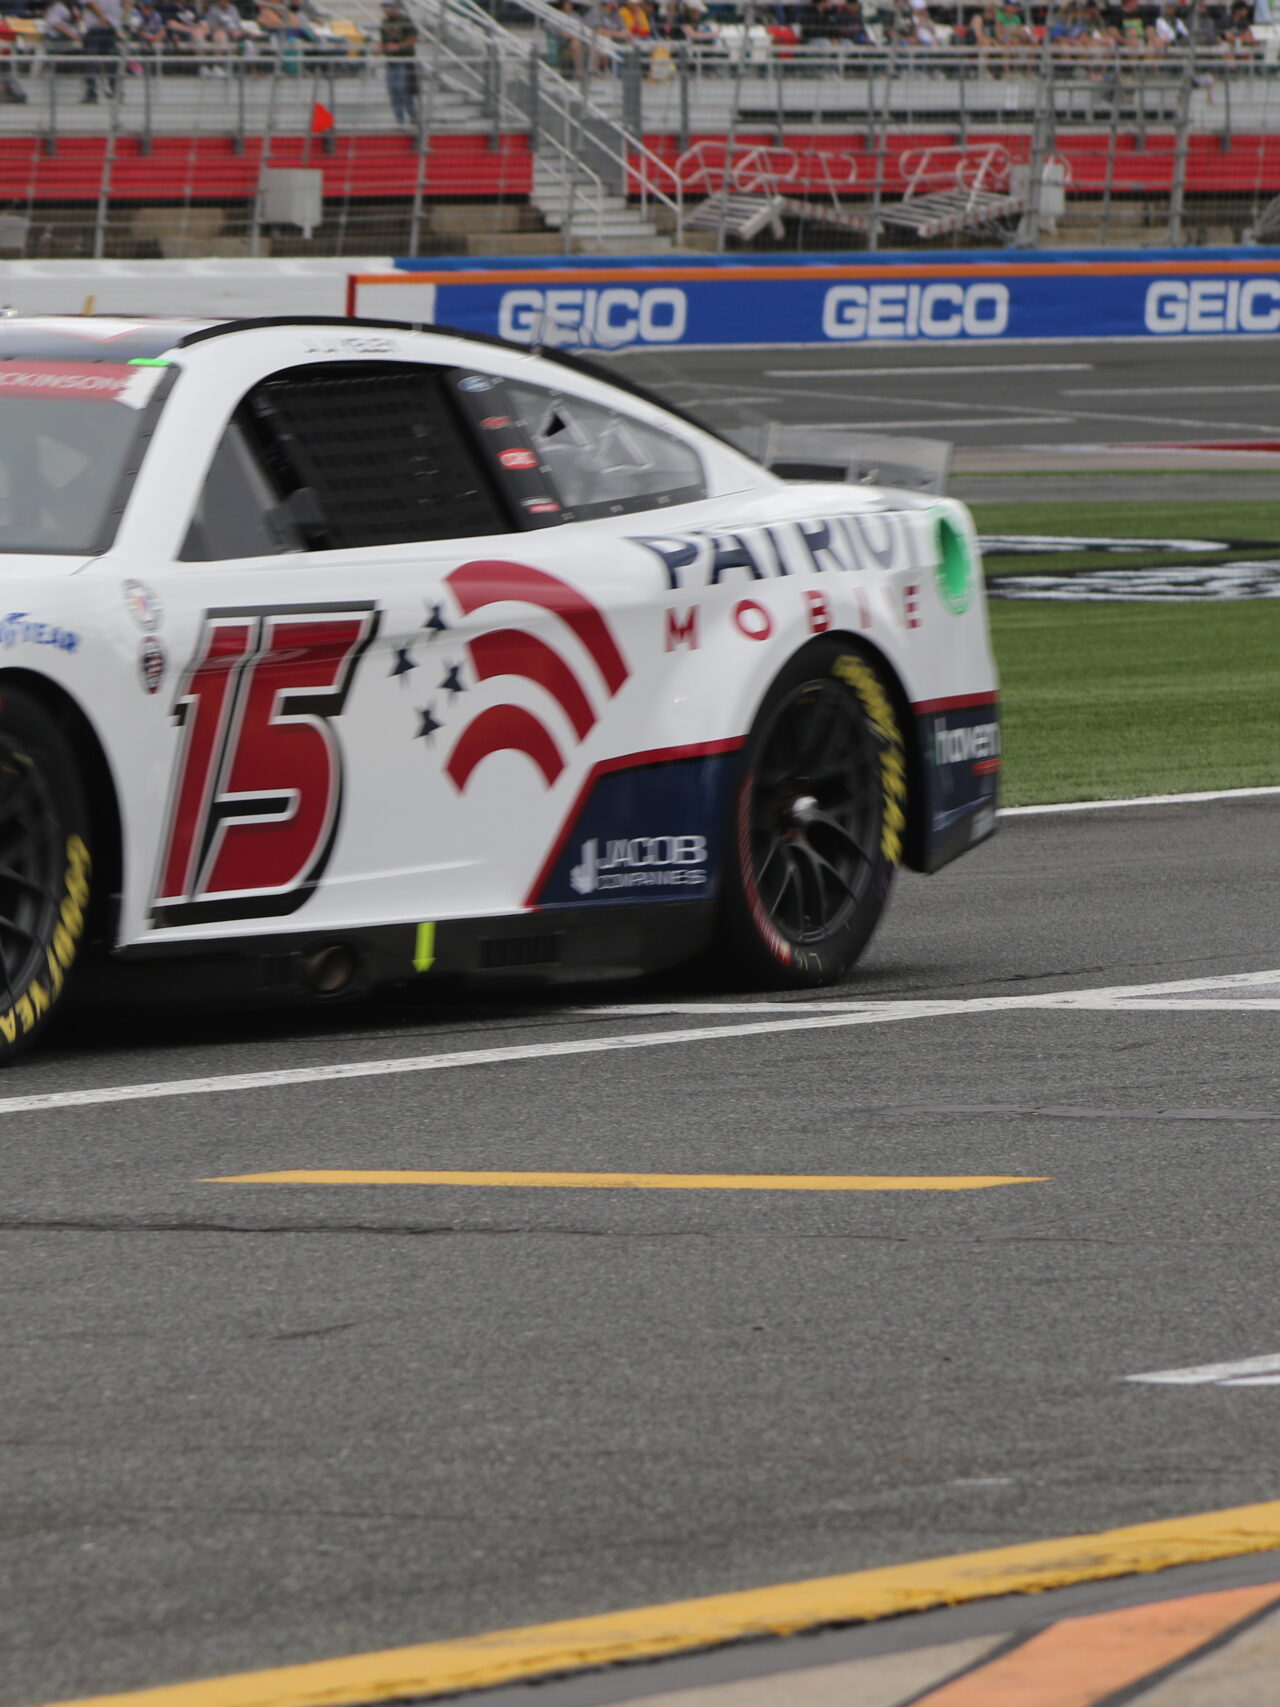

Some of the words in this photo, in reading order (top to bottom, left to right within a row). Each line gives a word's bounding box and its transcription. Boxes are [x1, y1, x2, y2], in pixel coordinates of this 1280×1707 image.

[498, 288, 687, 346] GEICO
[822, 283, 1010, 339] GEICO
[1144, 279, 1280, 334] GEIC
[149, 600, 384, 929] 15
[595, 835, 709, 869] JACOB
